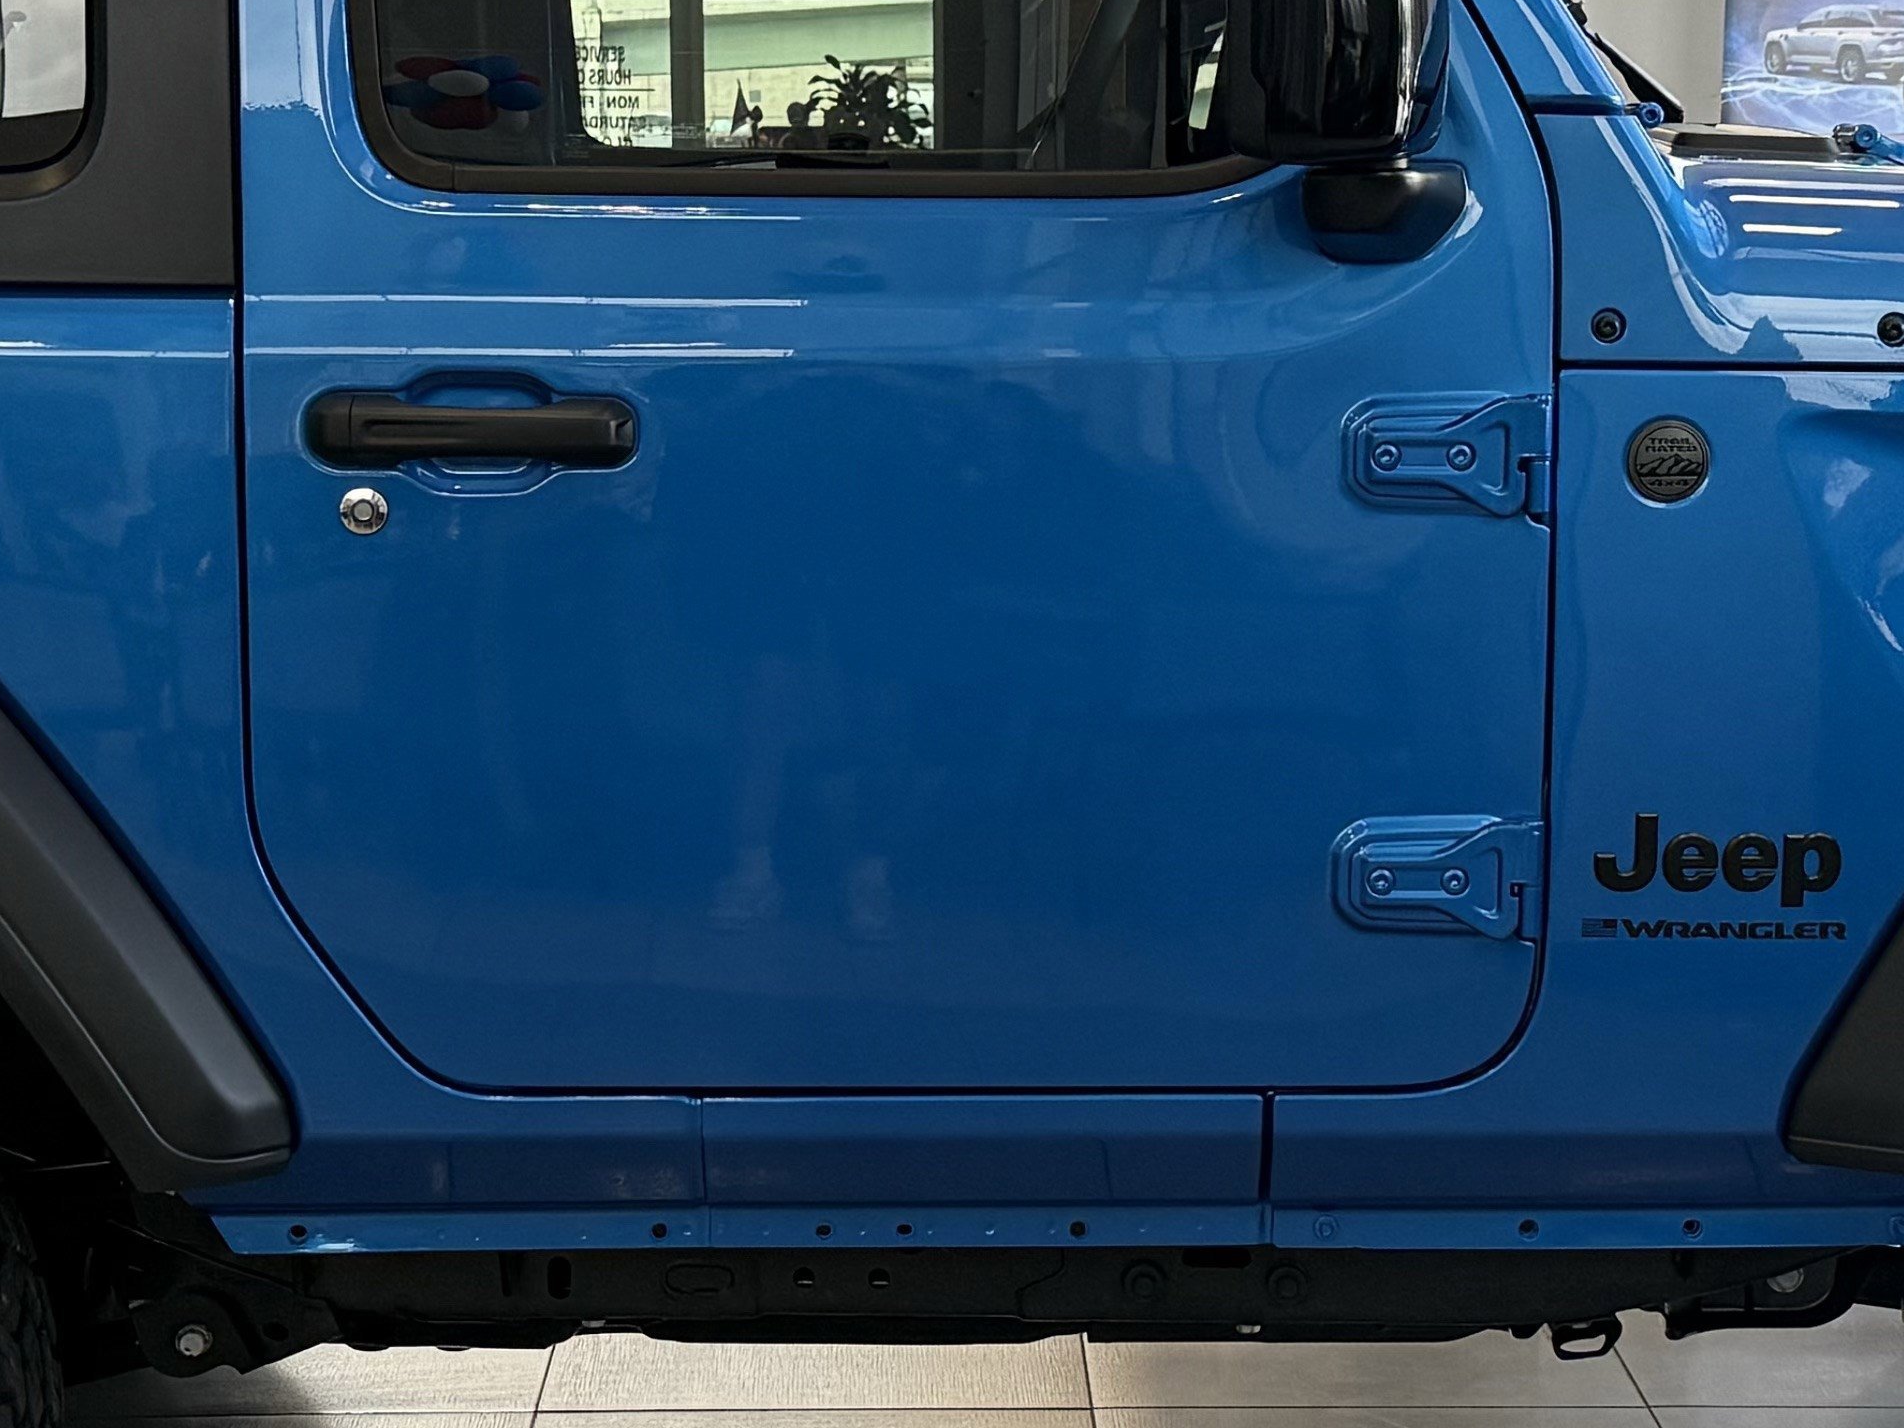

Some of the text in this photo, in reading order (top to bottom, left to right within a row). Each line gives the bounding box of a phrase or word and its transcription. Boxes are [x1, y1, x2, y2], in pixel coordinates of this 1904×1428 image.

[1645, 445, 1698, 453] RATED
[1649, 437, 1693, 446] TRAIL
[1592, 811, 1842, 908] Jeep
[1621, 919, 1847, 941] WRANGLER
